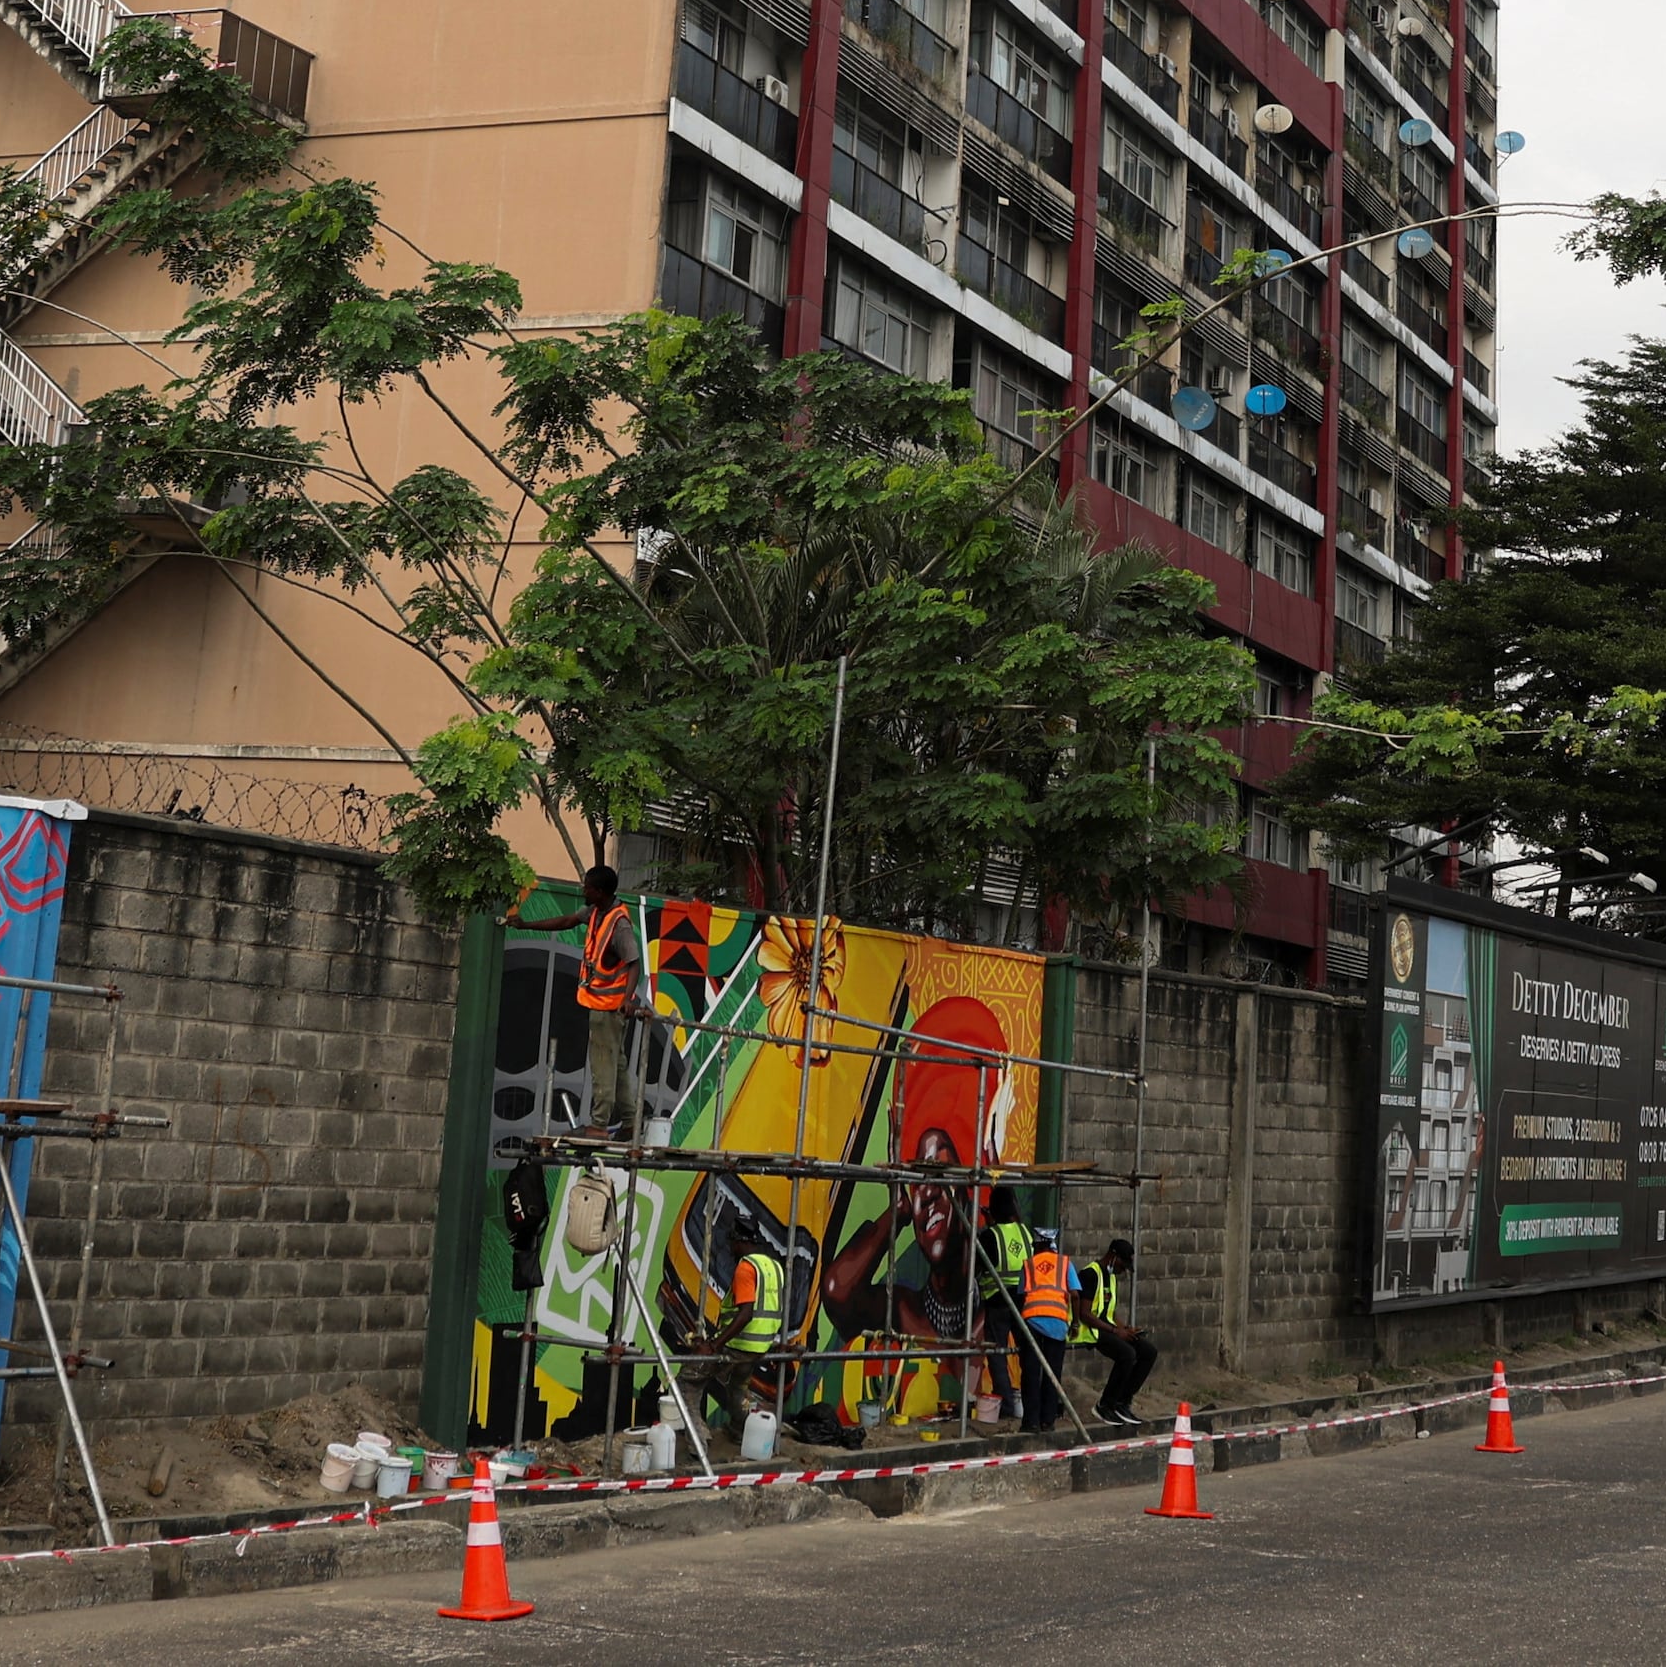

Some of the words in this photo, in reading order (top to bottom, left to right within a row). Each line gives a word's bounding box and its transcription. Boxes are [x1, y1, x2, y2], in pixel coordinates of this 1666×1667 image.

[1512, 971, 1560, 1018] DETTY
[1563, 981, 1630, 1029] DECEMBER
[1520, 1034, 1559, 1061] DESERVES
[1560, 1040, 1566, 1062] A
[1566, 1041, 1590, 1064] DETTY
[1589, 1044, 1621, 1069] ADDRESS
[1574, 1119, 1581, 1141] 2
[1534, 1156, 1577, 1181] APARTMENTS
[1577, 1157, 1585, 1180] IN
[1603, 1158, 1623, 1181] PHASE
[1518, 1218, 1541, 1240] DEPOSIT
